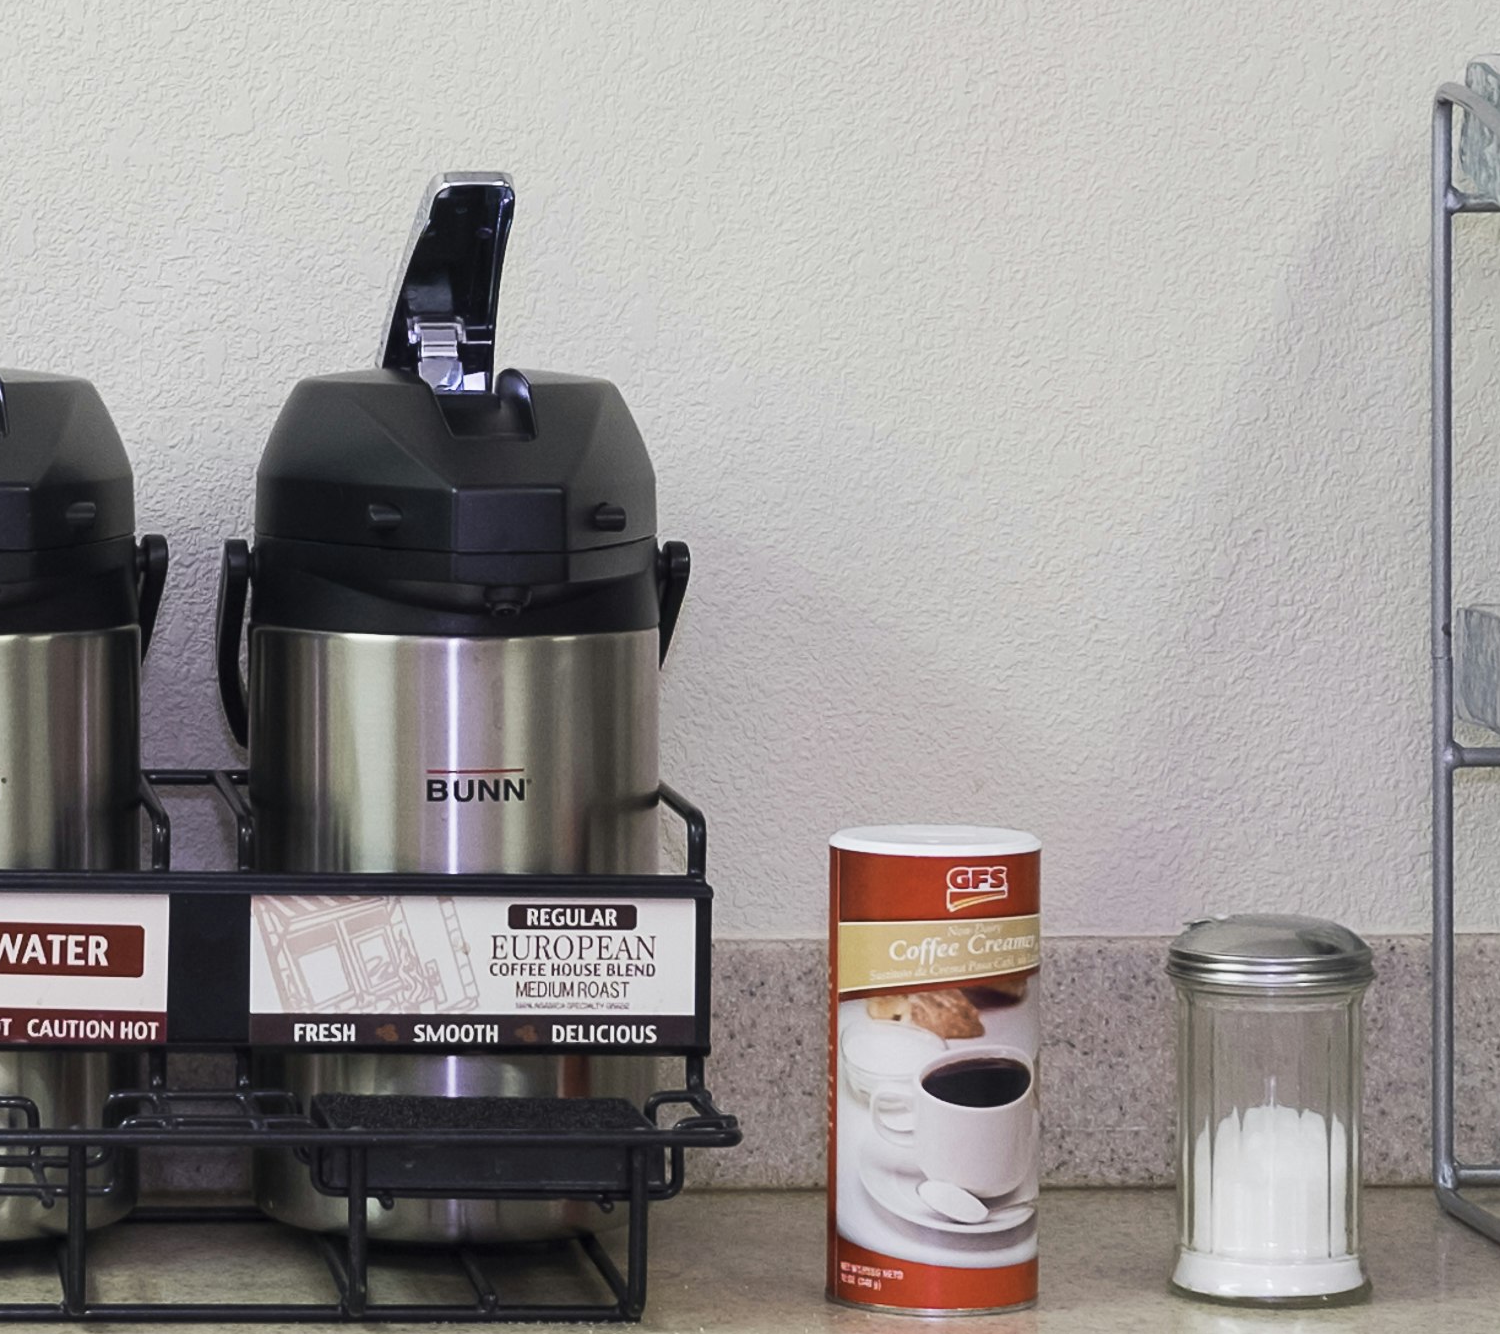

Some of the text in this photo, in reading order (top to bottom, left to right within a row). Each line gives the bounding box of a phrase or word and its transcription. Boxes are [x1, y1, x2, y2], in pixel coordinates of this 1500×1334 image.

[426, 778, 525, 802] BUNN
[948, 866, 1007, 890] GFS
[526, 908, 617, 927] REGULAR
[491, 935, 656, 961] EUROPEAN
[889, 937, 960, 965] Coffee
[489, 962, 656, 978] COFFEE HOUSE BLEND
[516, 981, 630, 999] MEDIUM ROAST
[27, 1018, 115, 1039] CAUTION
[120, 1021, 159, 1040] HOT
[293, 1023, 657, 1044] FRESH SMOOTH DELICIOUS
